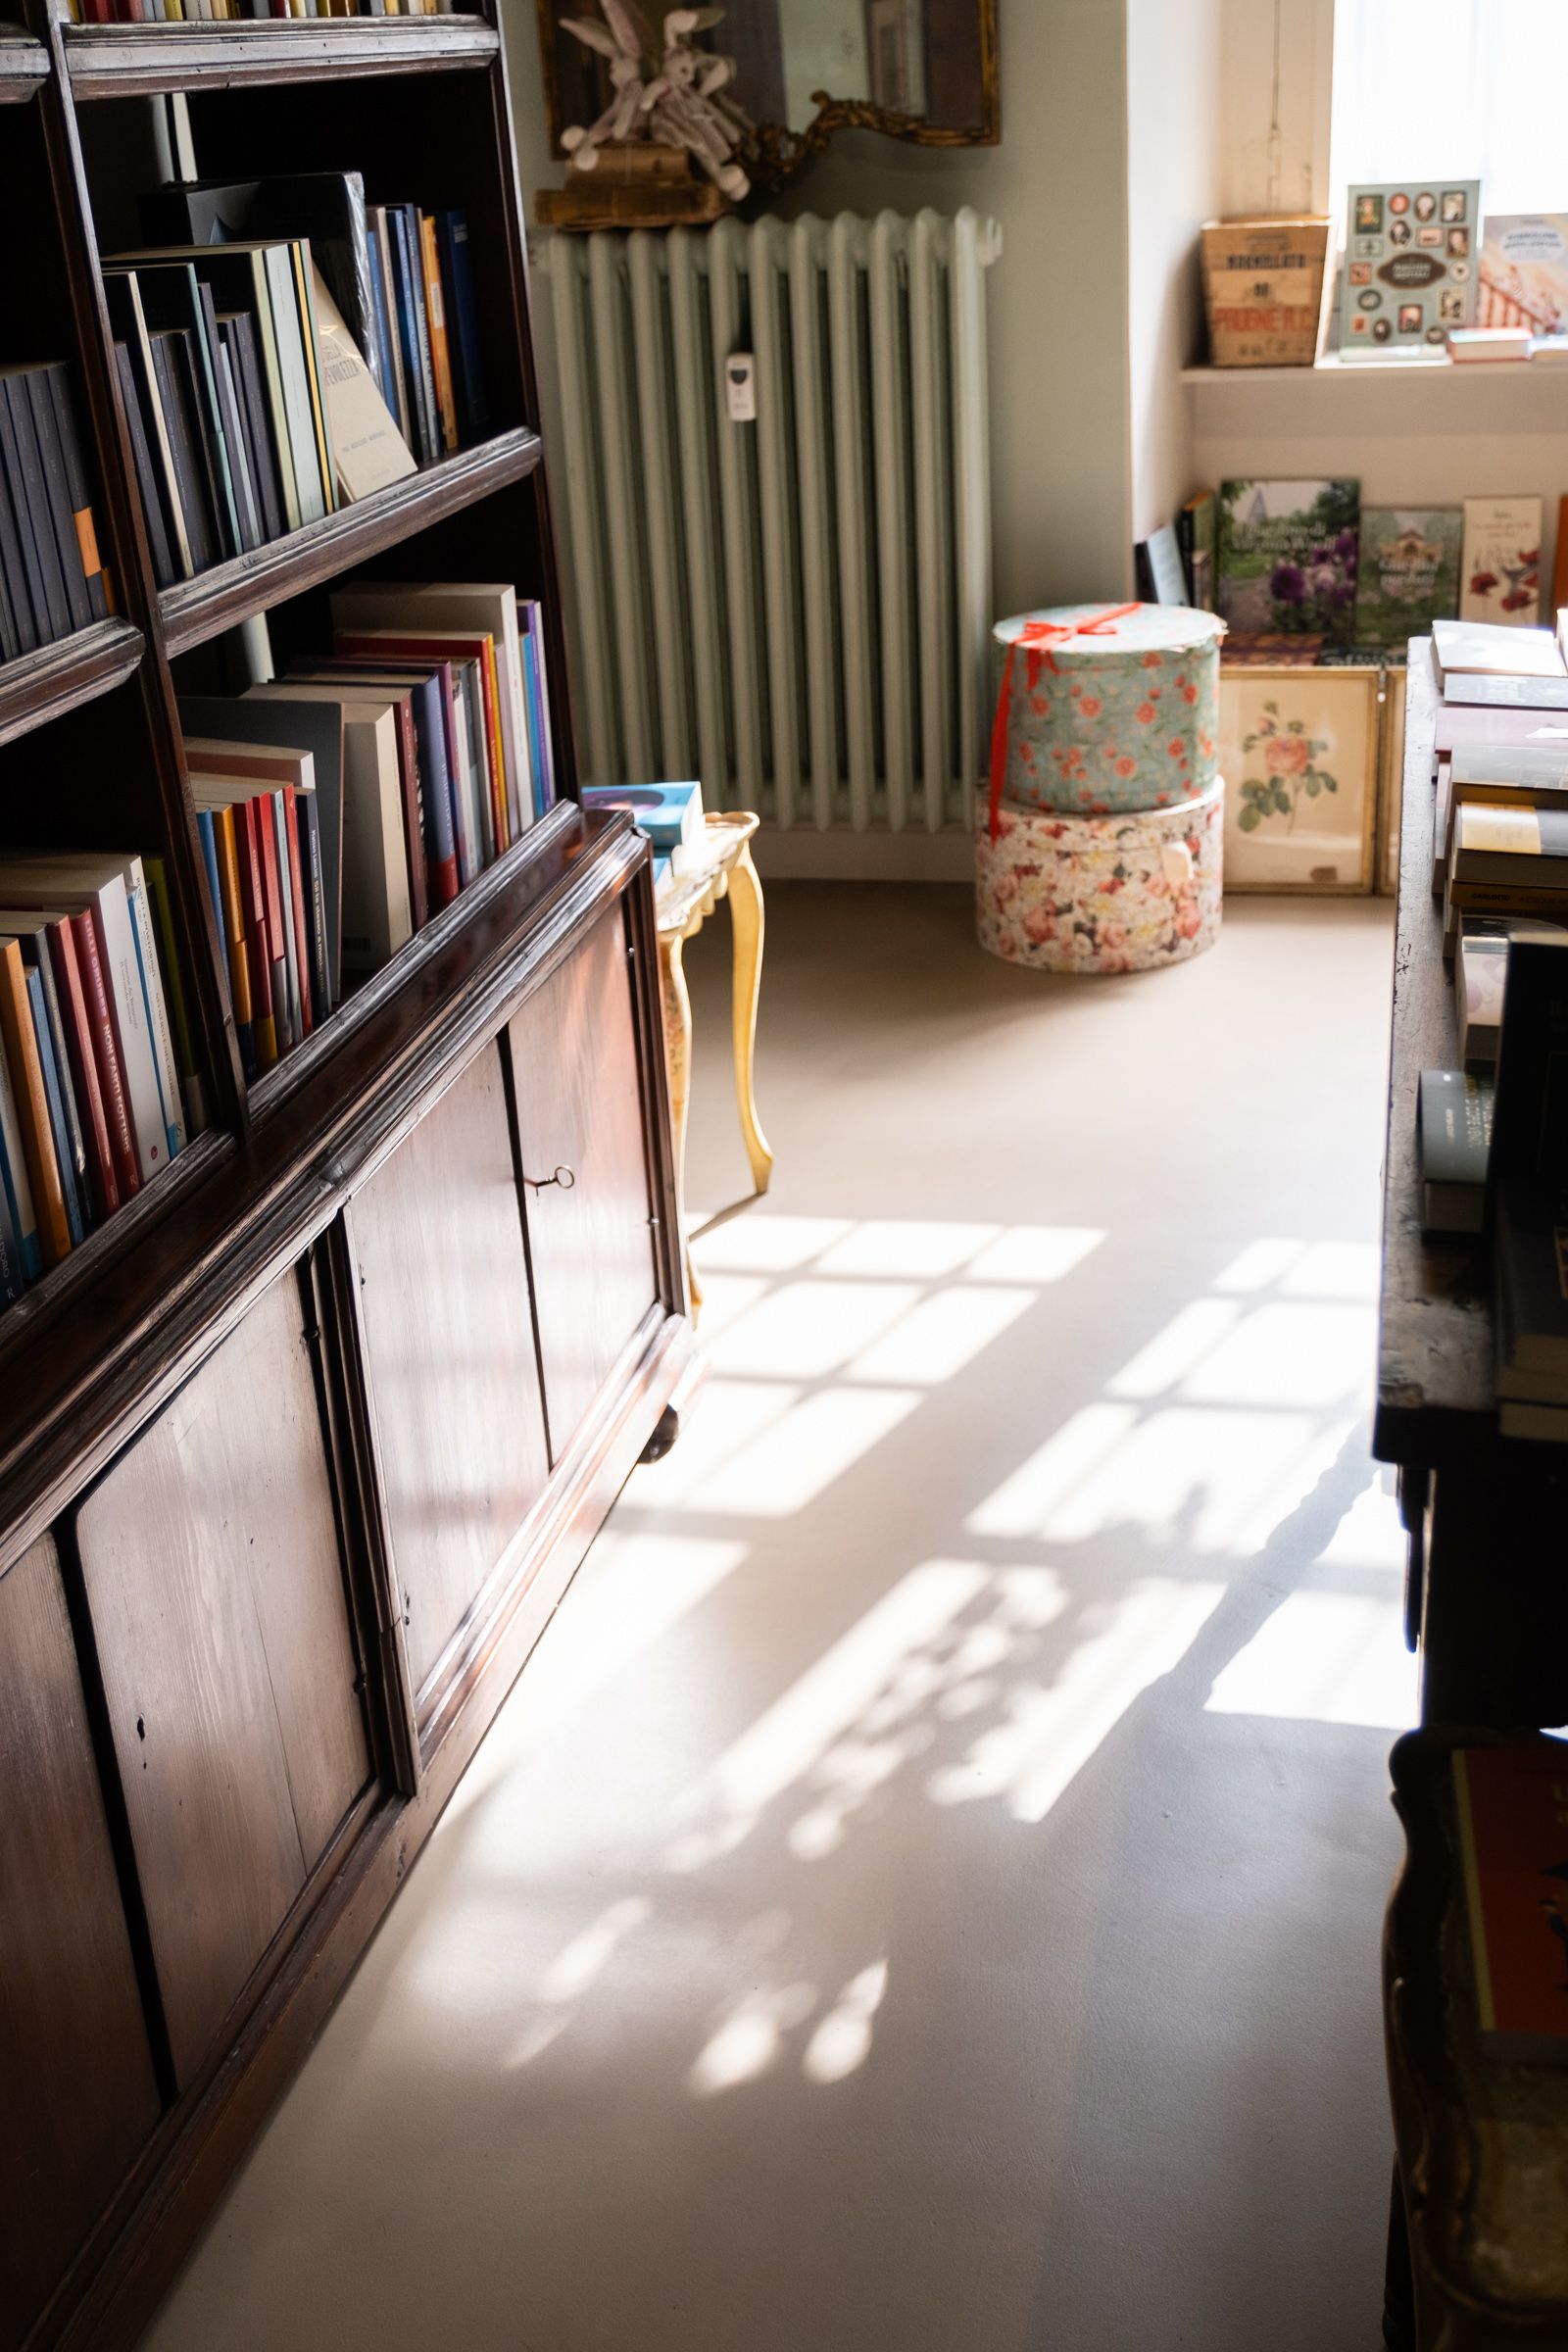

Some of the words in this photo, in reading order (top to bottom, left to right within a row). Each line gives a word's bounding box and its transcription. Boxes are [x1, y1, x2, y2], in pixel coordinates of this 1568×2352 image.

[1472, 893, 1511, 902] CARLOTTO
[84, 920, 96, 954] LILLI
[91, 956, 108, 1017] GRUBER
[103, 1024, 116, 1055] NON
[109, 1057, 122, 1095] FARTI
[117, 1096, 130, 1154] FOTTERE
